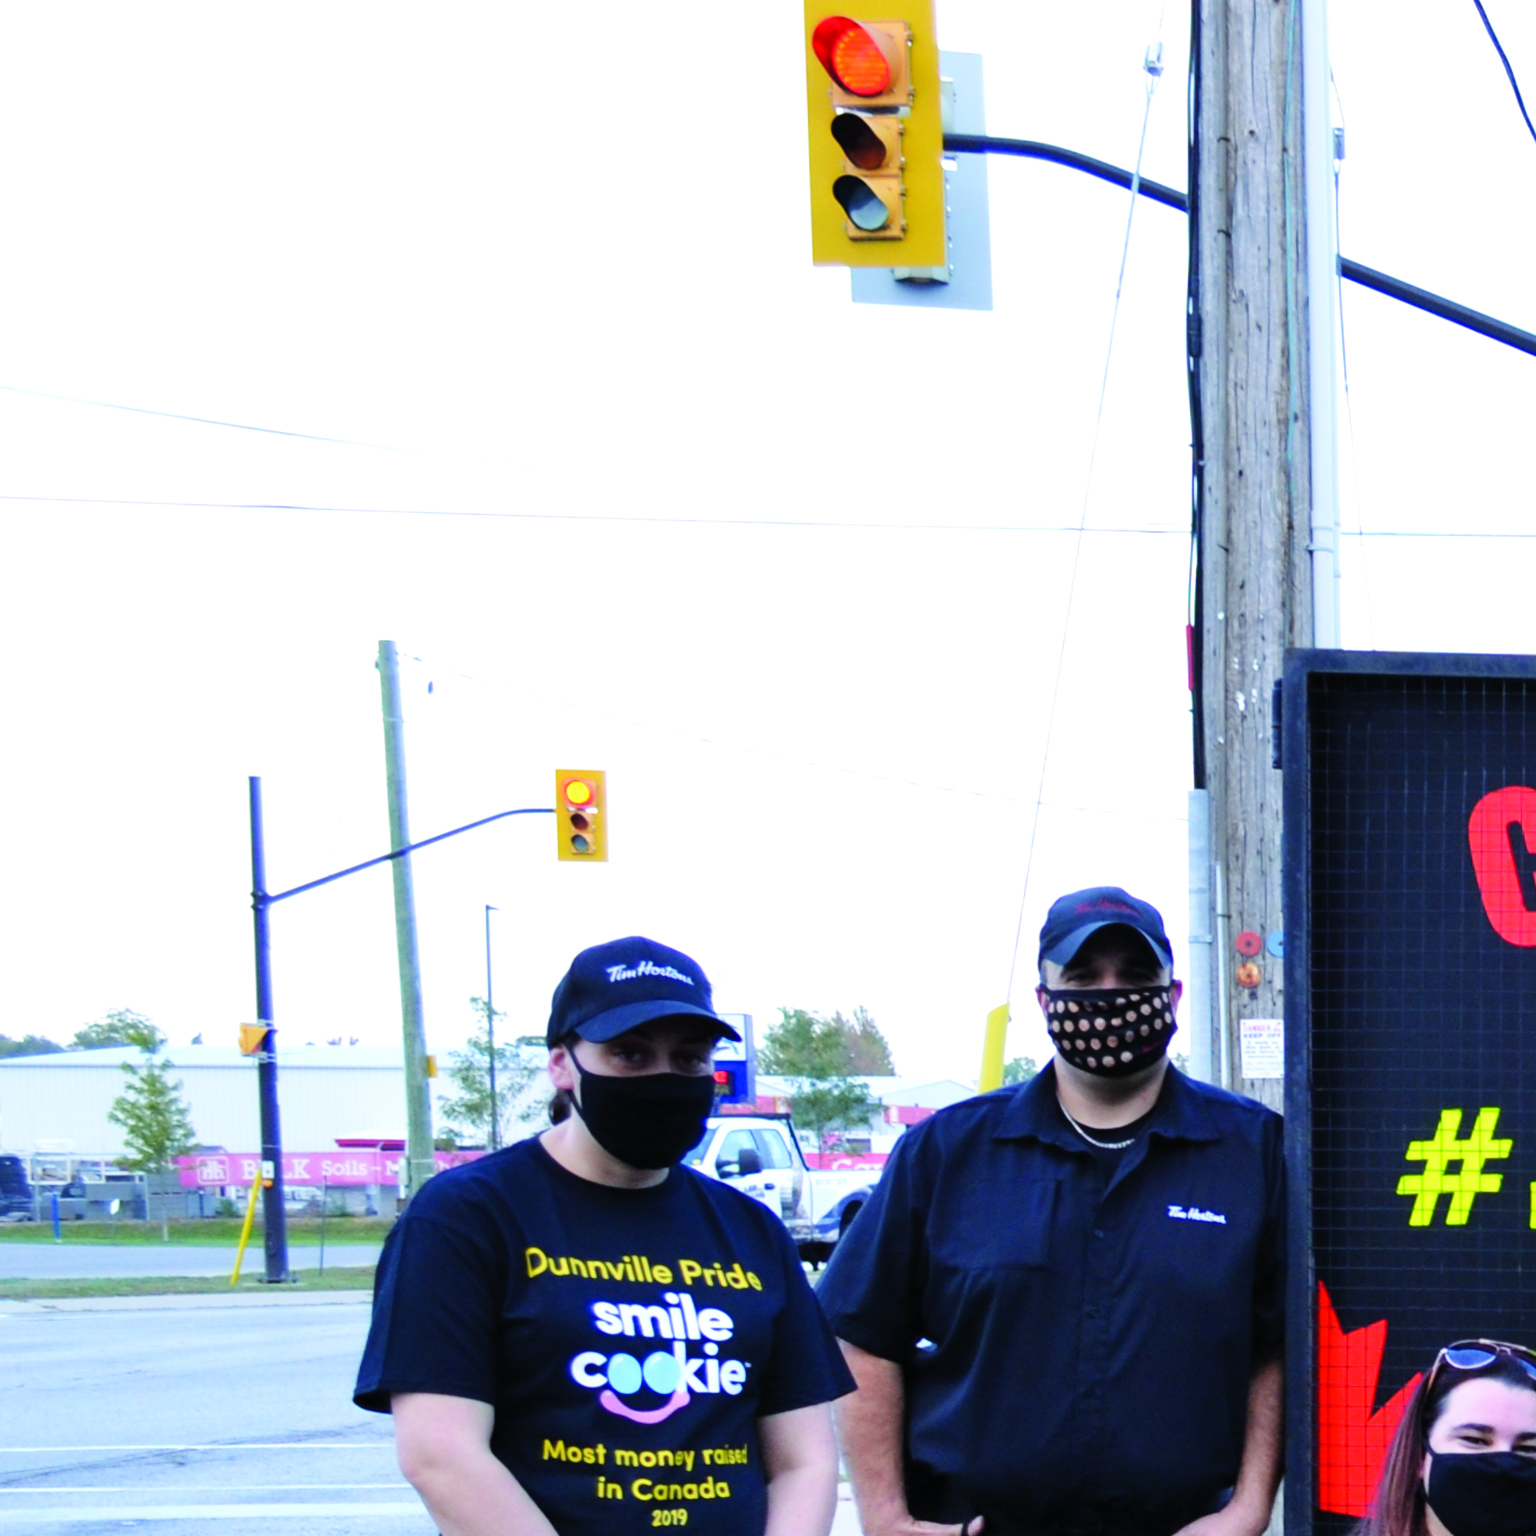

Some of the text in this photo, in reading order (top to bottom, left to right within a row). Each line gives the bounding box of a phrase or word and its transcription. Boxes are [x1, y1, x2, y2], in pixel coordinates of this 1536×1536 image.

[606, 964, 637, 983] Tim
[321, 1159, 368, 1177] Soils
[525, 1247, 763, 1291] Dunnville Pride
[592, 1292, 734, 1342] smile
[570, 1341, 747, 1396] cookie
[542, 1439, 748, 1471] Most money raised
[596, 1476, 731, 1501] in Canada
[651, 1508, 688, 1527] 2019
